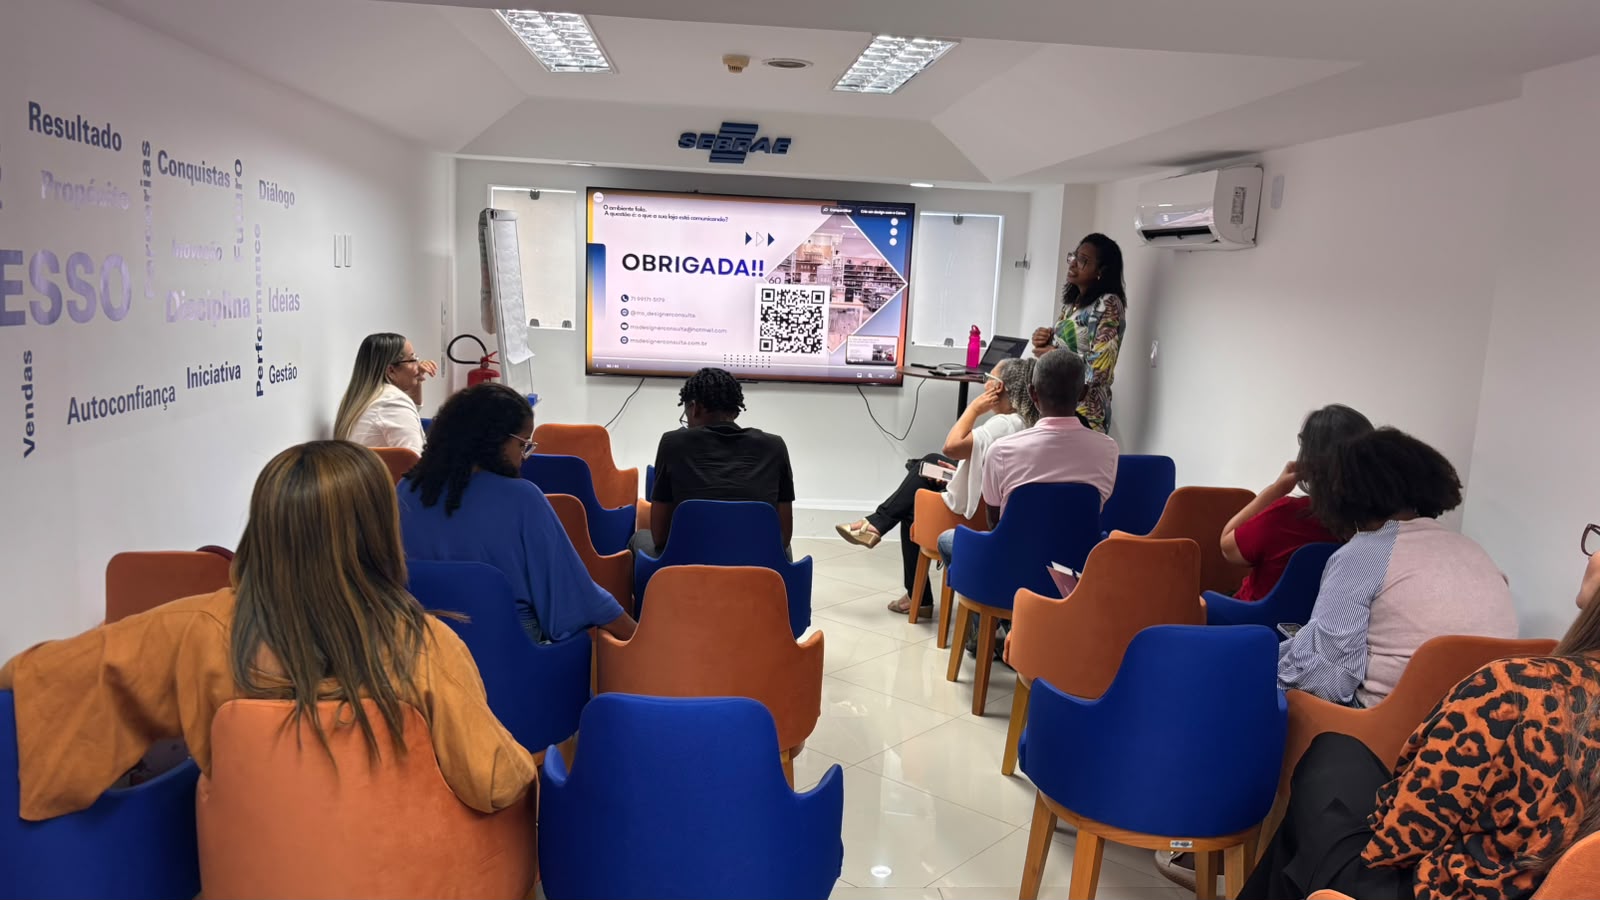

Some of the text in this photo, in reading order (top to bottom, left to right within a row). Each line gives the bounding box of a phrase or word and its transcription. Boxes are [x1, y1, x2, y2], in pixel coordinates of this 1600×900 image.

[28, 101, 122, 151] Resultado
[678, 132, 791, 154] SEBRAE
[157, 150, 231, 188] Conquistas
[258, 179, 295, 209] Diálogo
[622, 253, 764, 277] OBRIGADA!!
[0, 249, 132, 327] ESSO
[268, 287, 300, 313] Ideias
[165, 289, 250, 327] Disciplina
[254, 224, 264, 397] Performance
[187, 361, 241, 389] Iniciativa
[269, 362, 298, 384] Gestão
[21, 350, 36, 458] Vendas
[67, 385, 176, 425] Autoconfiança
